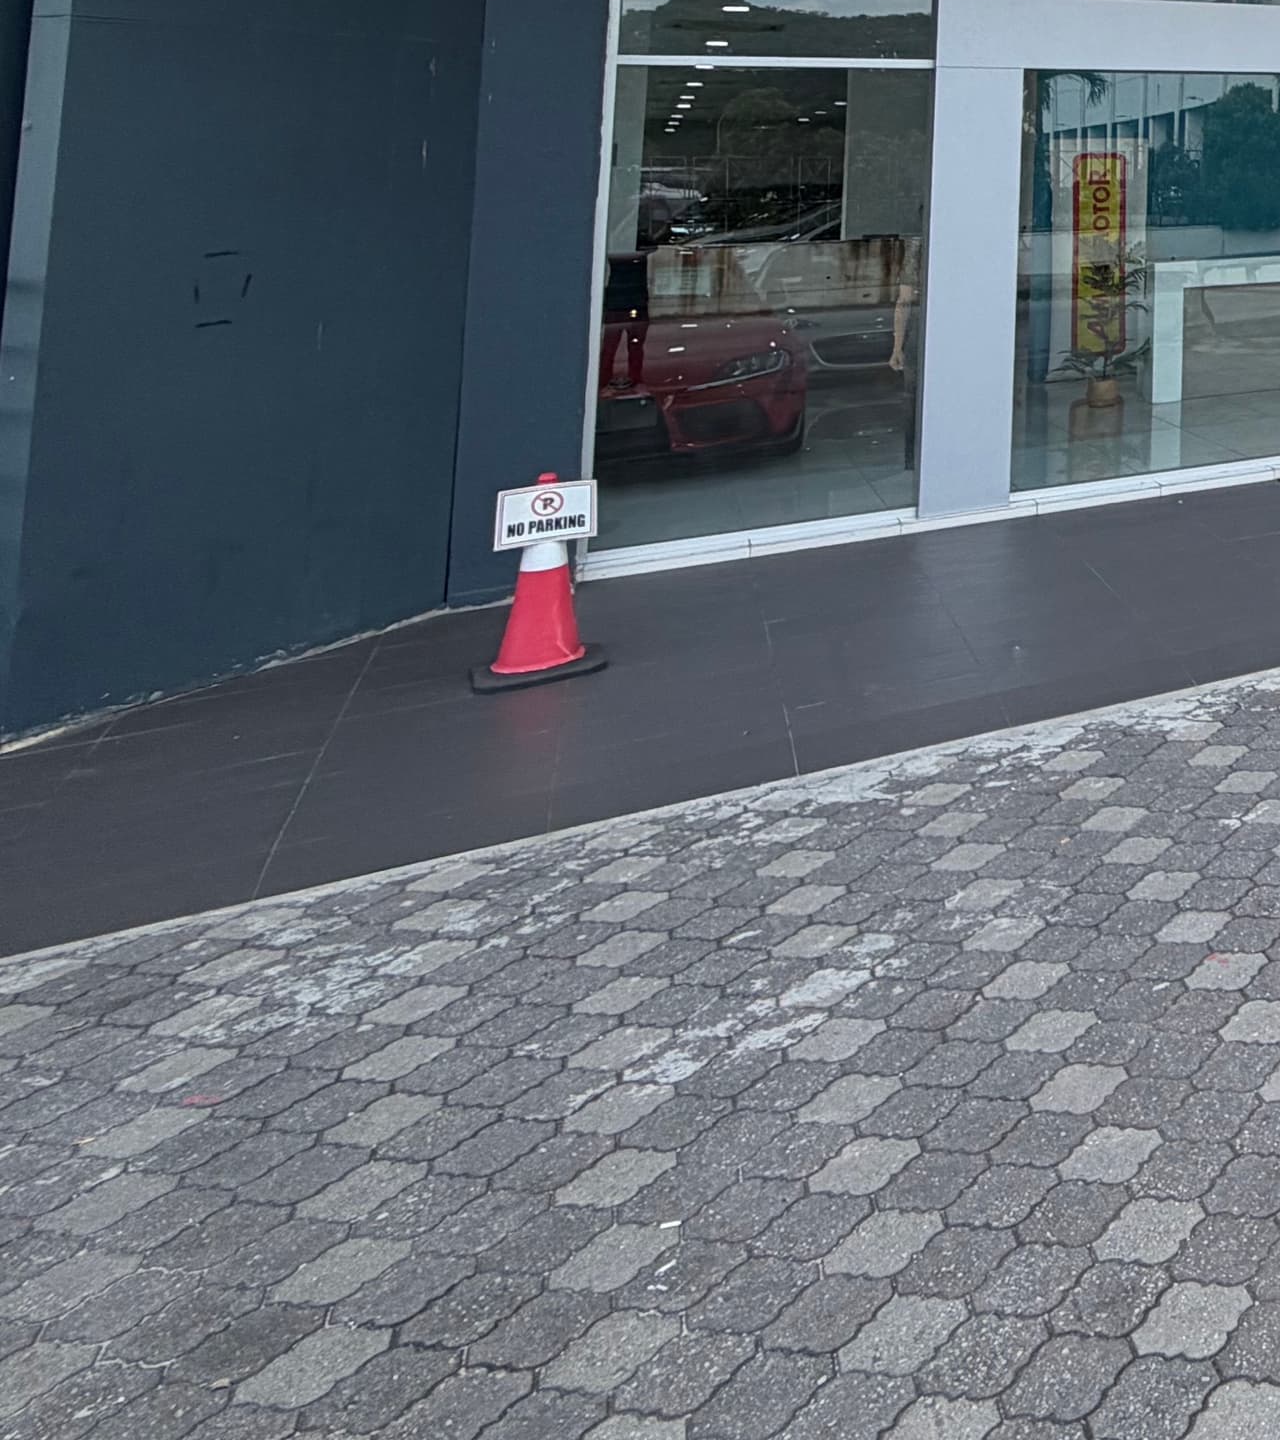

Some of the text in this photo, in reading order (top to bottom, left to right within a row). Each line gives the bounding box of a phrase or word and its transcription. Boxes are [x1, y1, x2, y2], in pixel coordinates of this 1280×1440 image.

[1088, 168, 1111, 250] OTOR
[507, 514, 586, 538] NO PARKING
